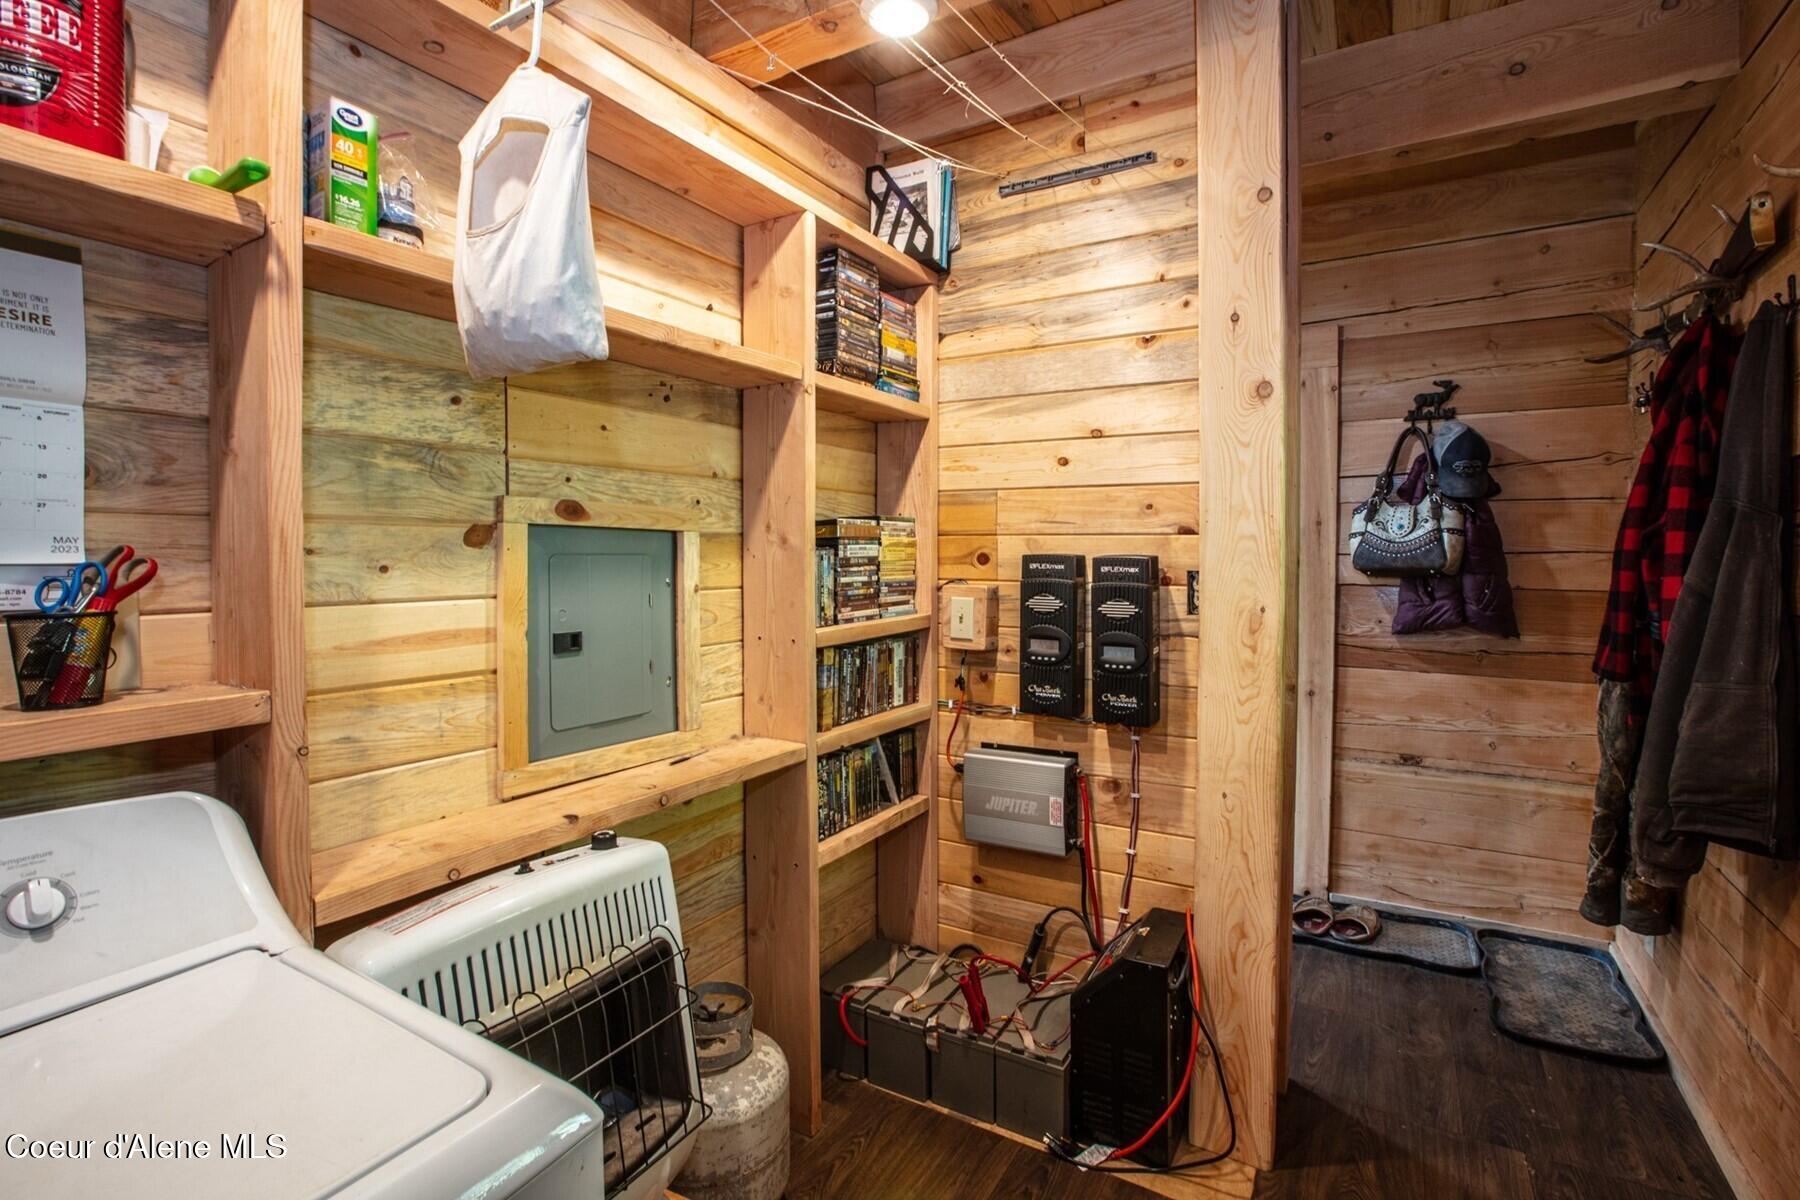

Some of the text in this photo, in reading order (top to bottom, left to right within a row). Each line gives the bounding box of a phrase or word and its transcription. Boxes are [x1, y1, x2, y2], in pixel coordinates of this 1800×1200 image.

[335, 138, 354, 156] 40
[12, 290, 27, 300] NOT
[30, 294, 49, 305] ONLY
[53, 535, 80, 545] MAY
[50, 545, 80, 554] 2023
[985, 795, 1037, 815] JUPITER
